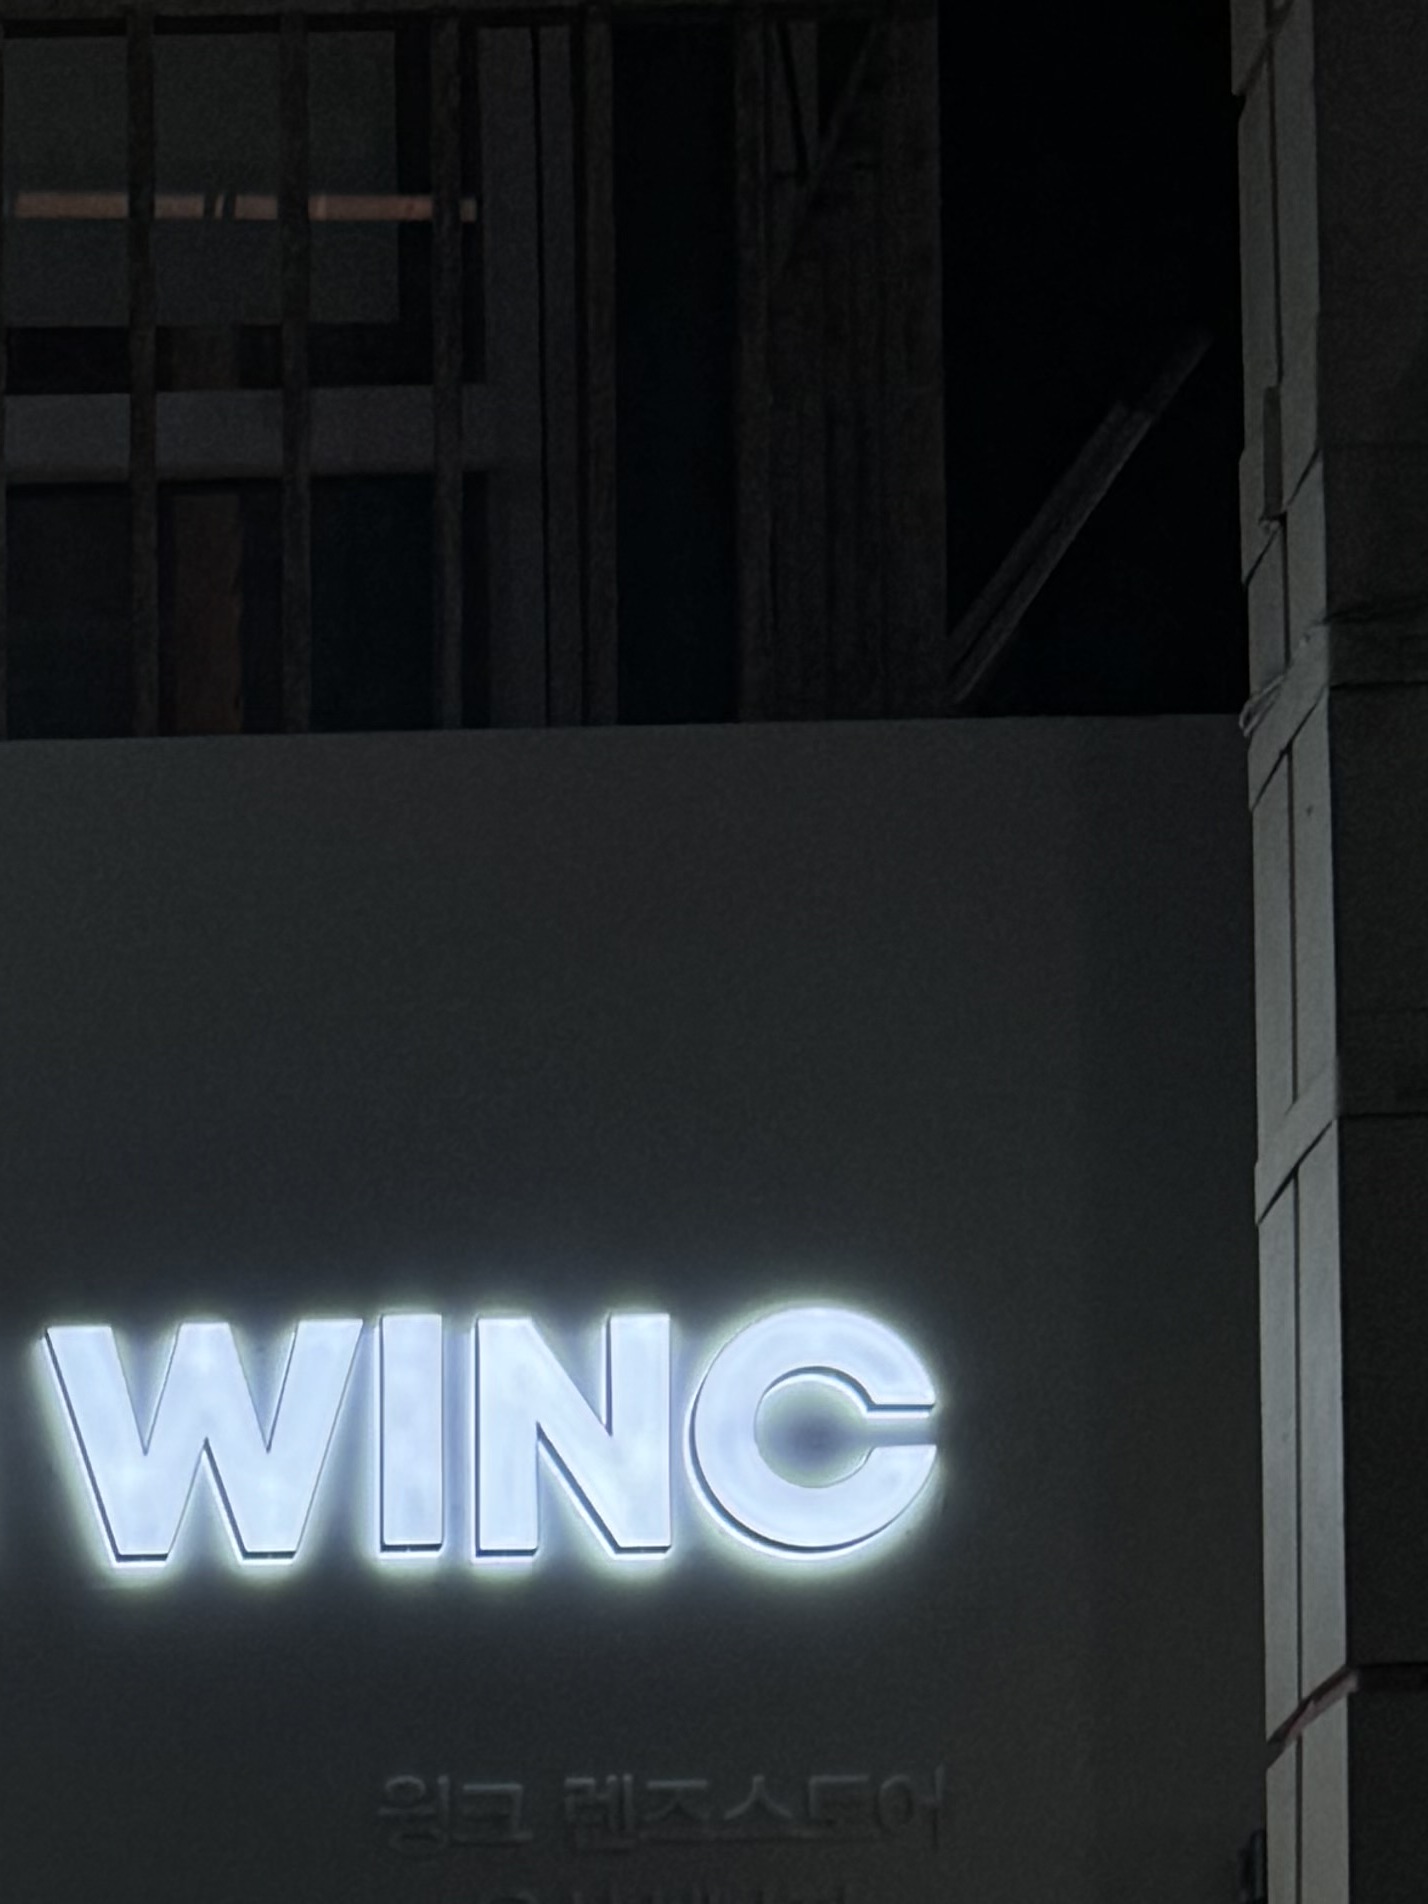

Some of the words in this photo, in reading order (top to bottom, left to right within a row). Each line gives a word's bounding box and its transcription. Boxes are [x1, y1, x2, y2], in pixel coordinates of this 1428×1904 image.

[40, 1304, 940, 1567] WINC
[375, 1772, 536, 1852] 윙크
[563, 1762, 950, 1853] 렌즈스토어
